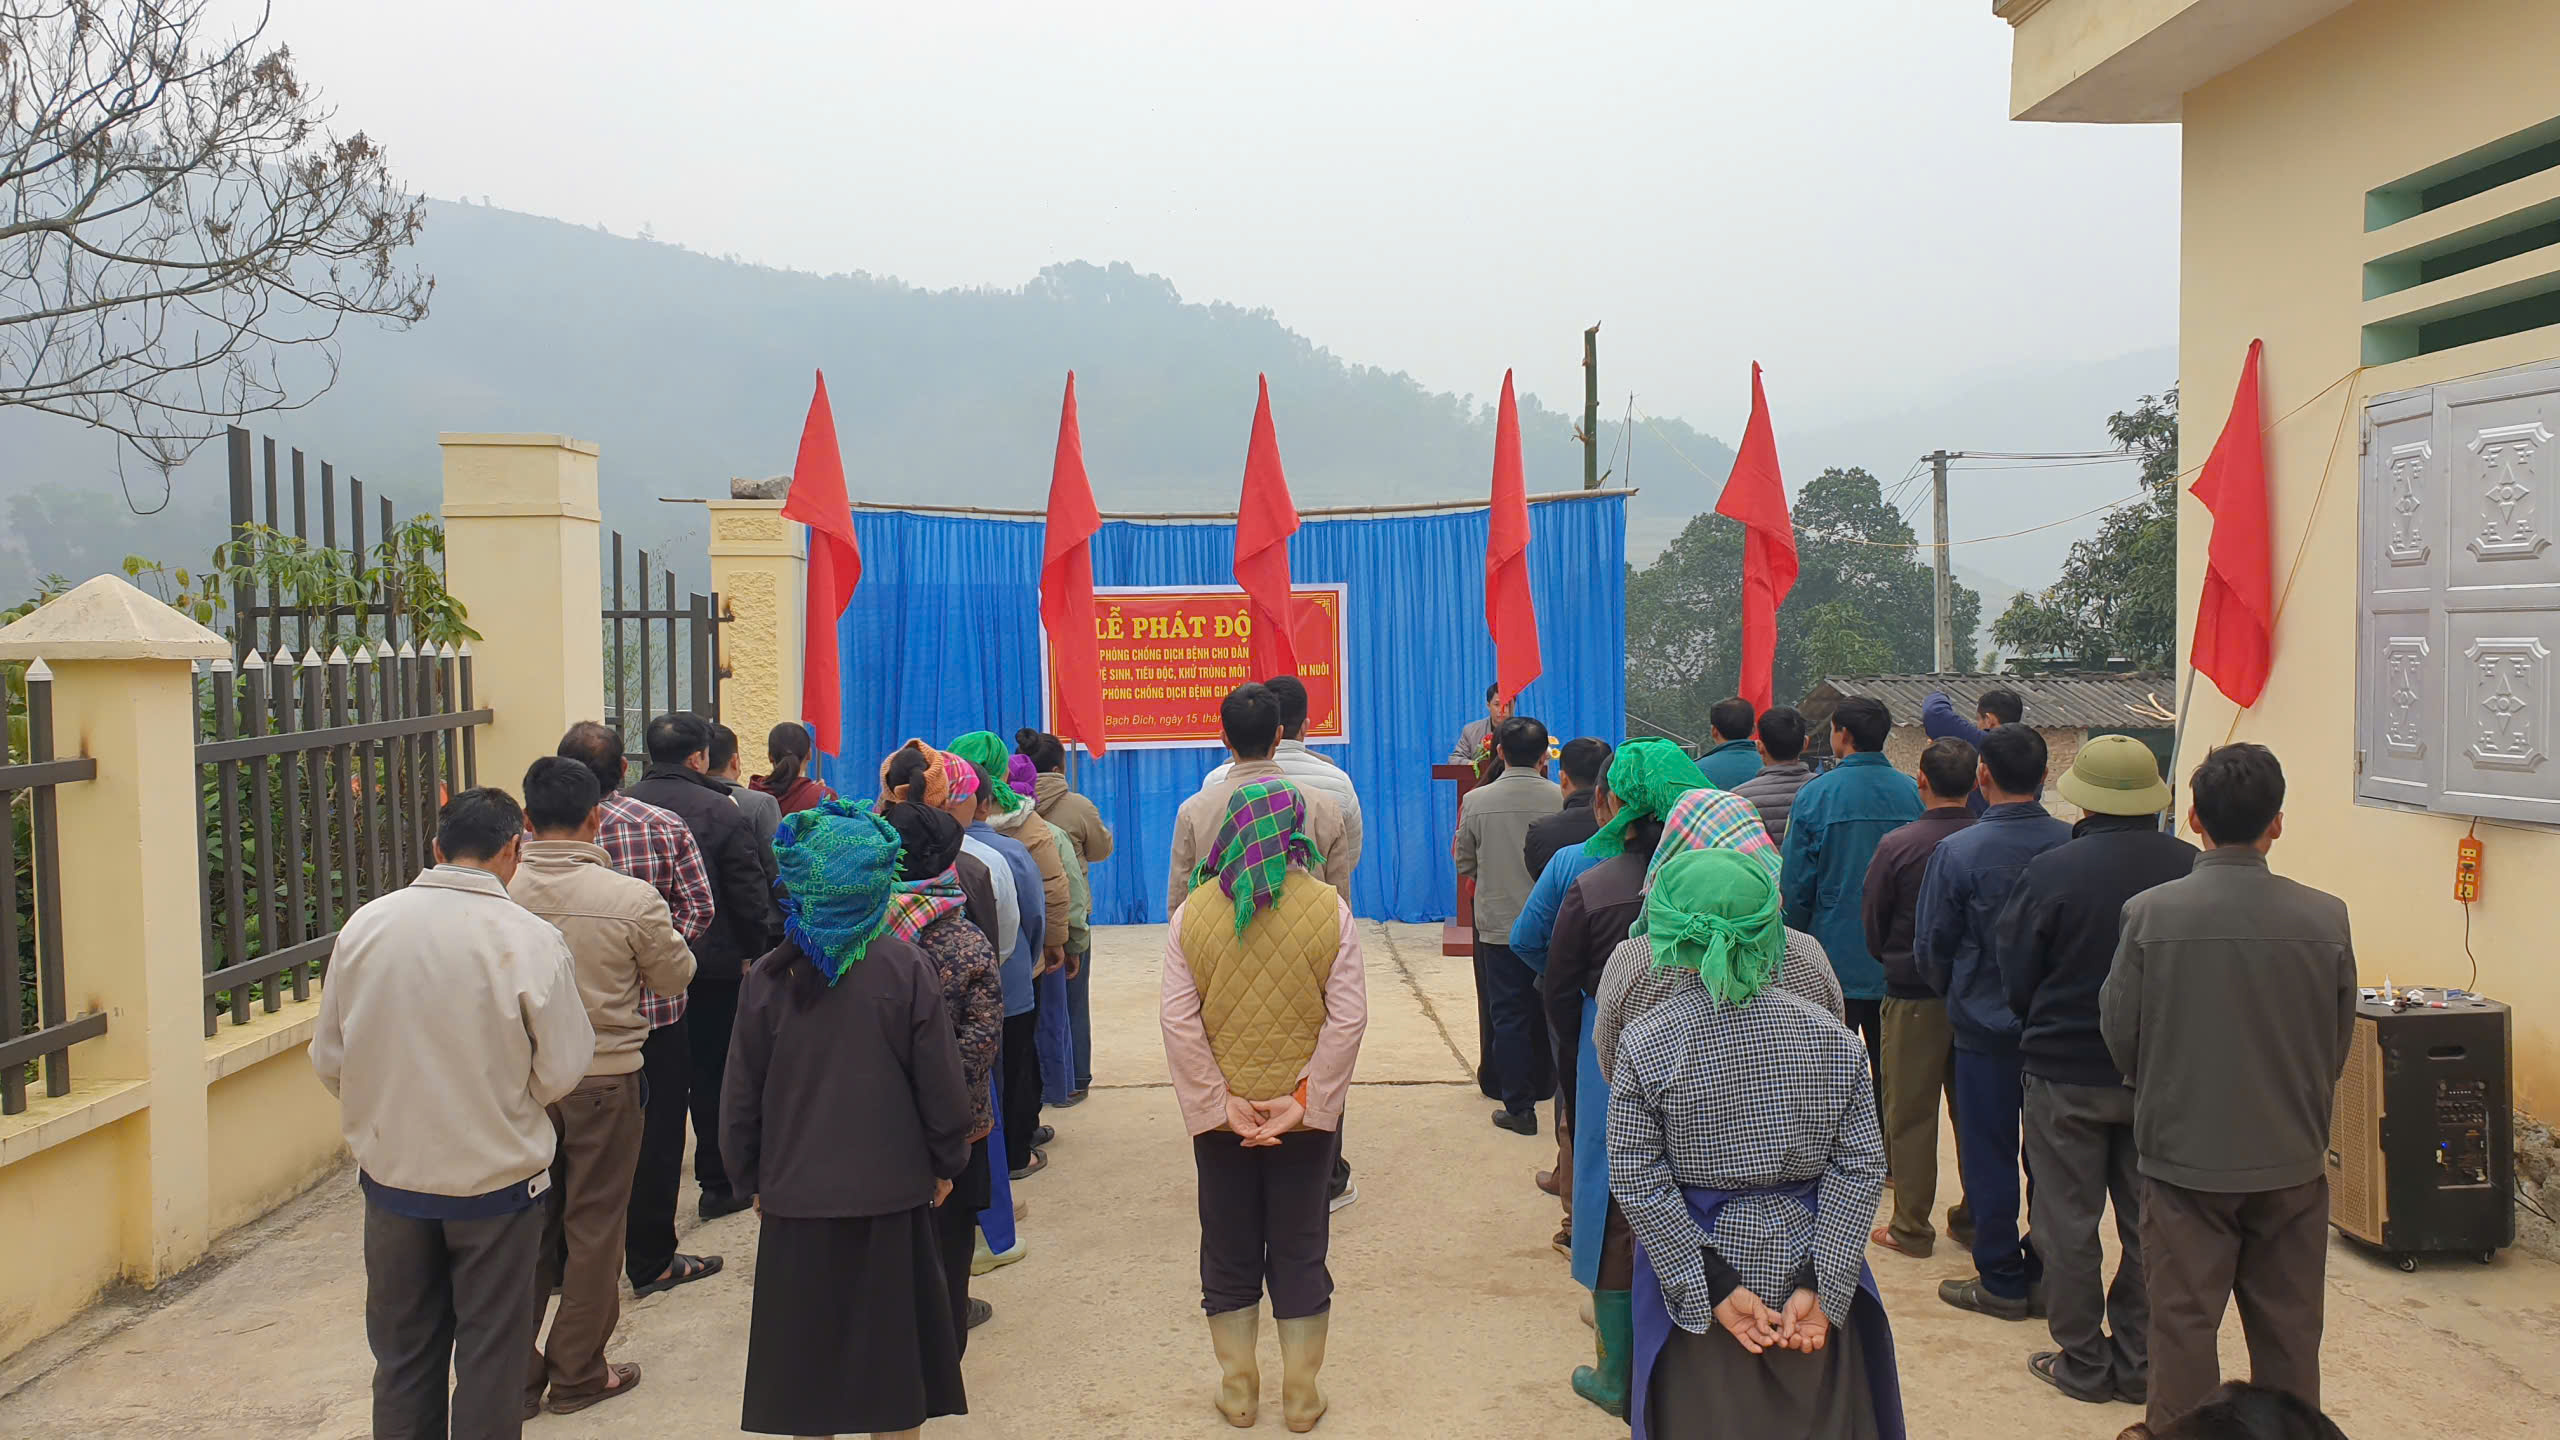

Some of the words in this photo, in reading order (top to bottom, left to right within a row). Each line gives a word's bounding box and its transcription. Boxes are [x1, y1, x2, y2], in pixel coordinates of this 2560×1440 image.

[1096, 606, 1125, 639] LỄ
[1131, 610, 1207, 638] PHÁT
[1100, 646, 1130, 661] PHÒNG
[1132, 644, 1161, 660] CHỐNG
[1164, 647, 1184, 662] DỊCH
[1186, 645, 1210, 662] BỆNH
[1212, 646, 1229, 659] CHO
[1109, 668, 1134, 681] SINH,
[1156, 665, 1177, 682] ĐỘC,
[1198, 664, 1226, 679] TRÙNG
[1229, 663, 1246, 678] MÔI
[1309, 661, 1329, 676] NUÔI
[1102, 685, 1132, 700] PHÒNG
[1134, 683, 1164, 699] CHỐNG
[1166, 686, 1187, 701] DỊCH
[1189, 684, 1212, 700] BỆNH
[1214, 685, 1229, 698] GIA
[1105, 714, 1130, 727] Bạch
[1159, 713, 1183, 728] ngày
[1186, 713, 1198, 724] 15
